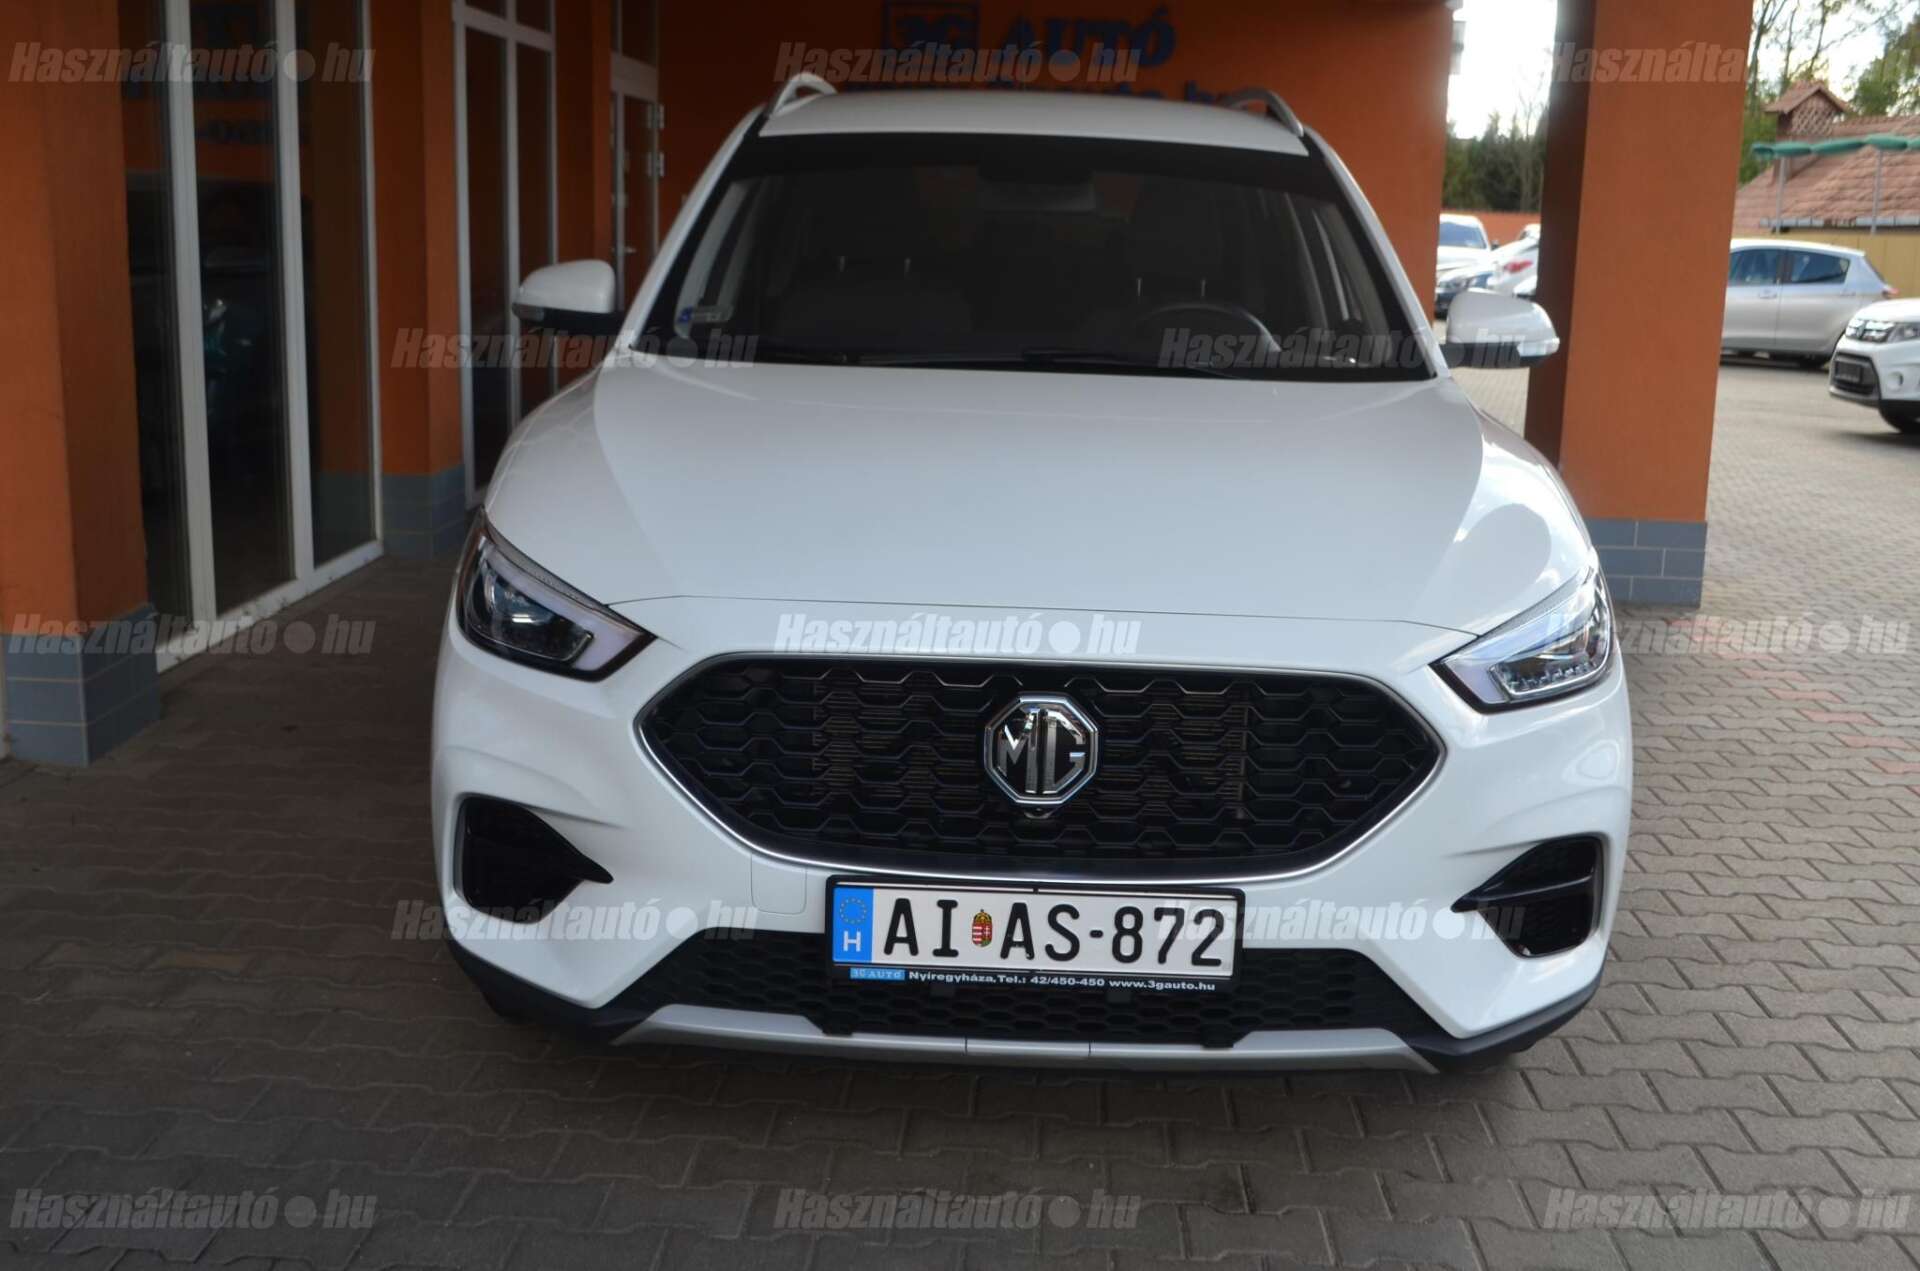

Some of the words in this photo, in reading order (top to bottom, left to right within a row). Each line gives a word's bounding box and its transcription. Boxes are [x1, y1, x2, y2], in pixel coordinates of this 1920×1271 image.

[996, 708, 1086, 795] MG
[842, 930, 862, 953] H
[999, 902, 1225, 967] AS-872
[1030, 976, 1105, 987] 42/450-450
[1108, 980, 1216, 991] www.3gauto.hu
